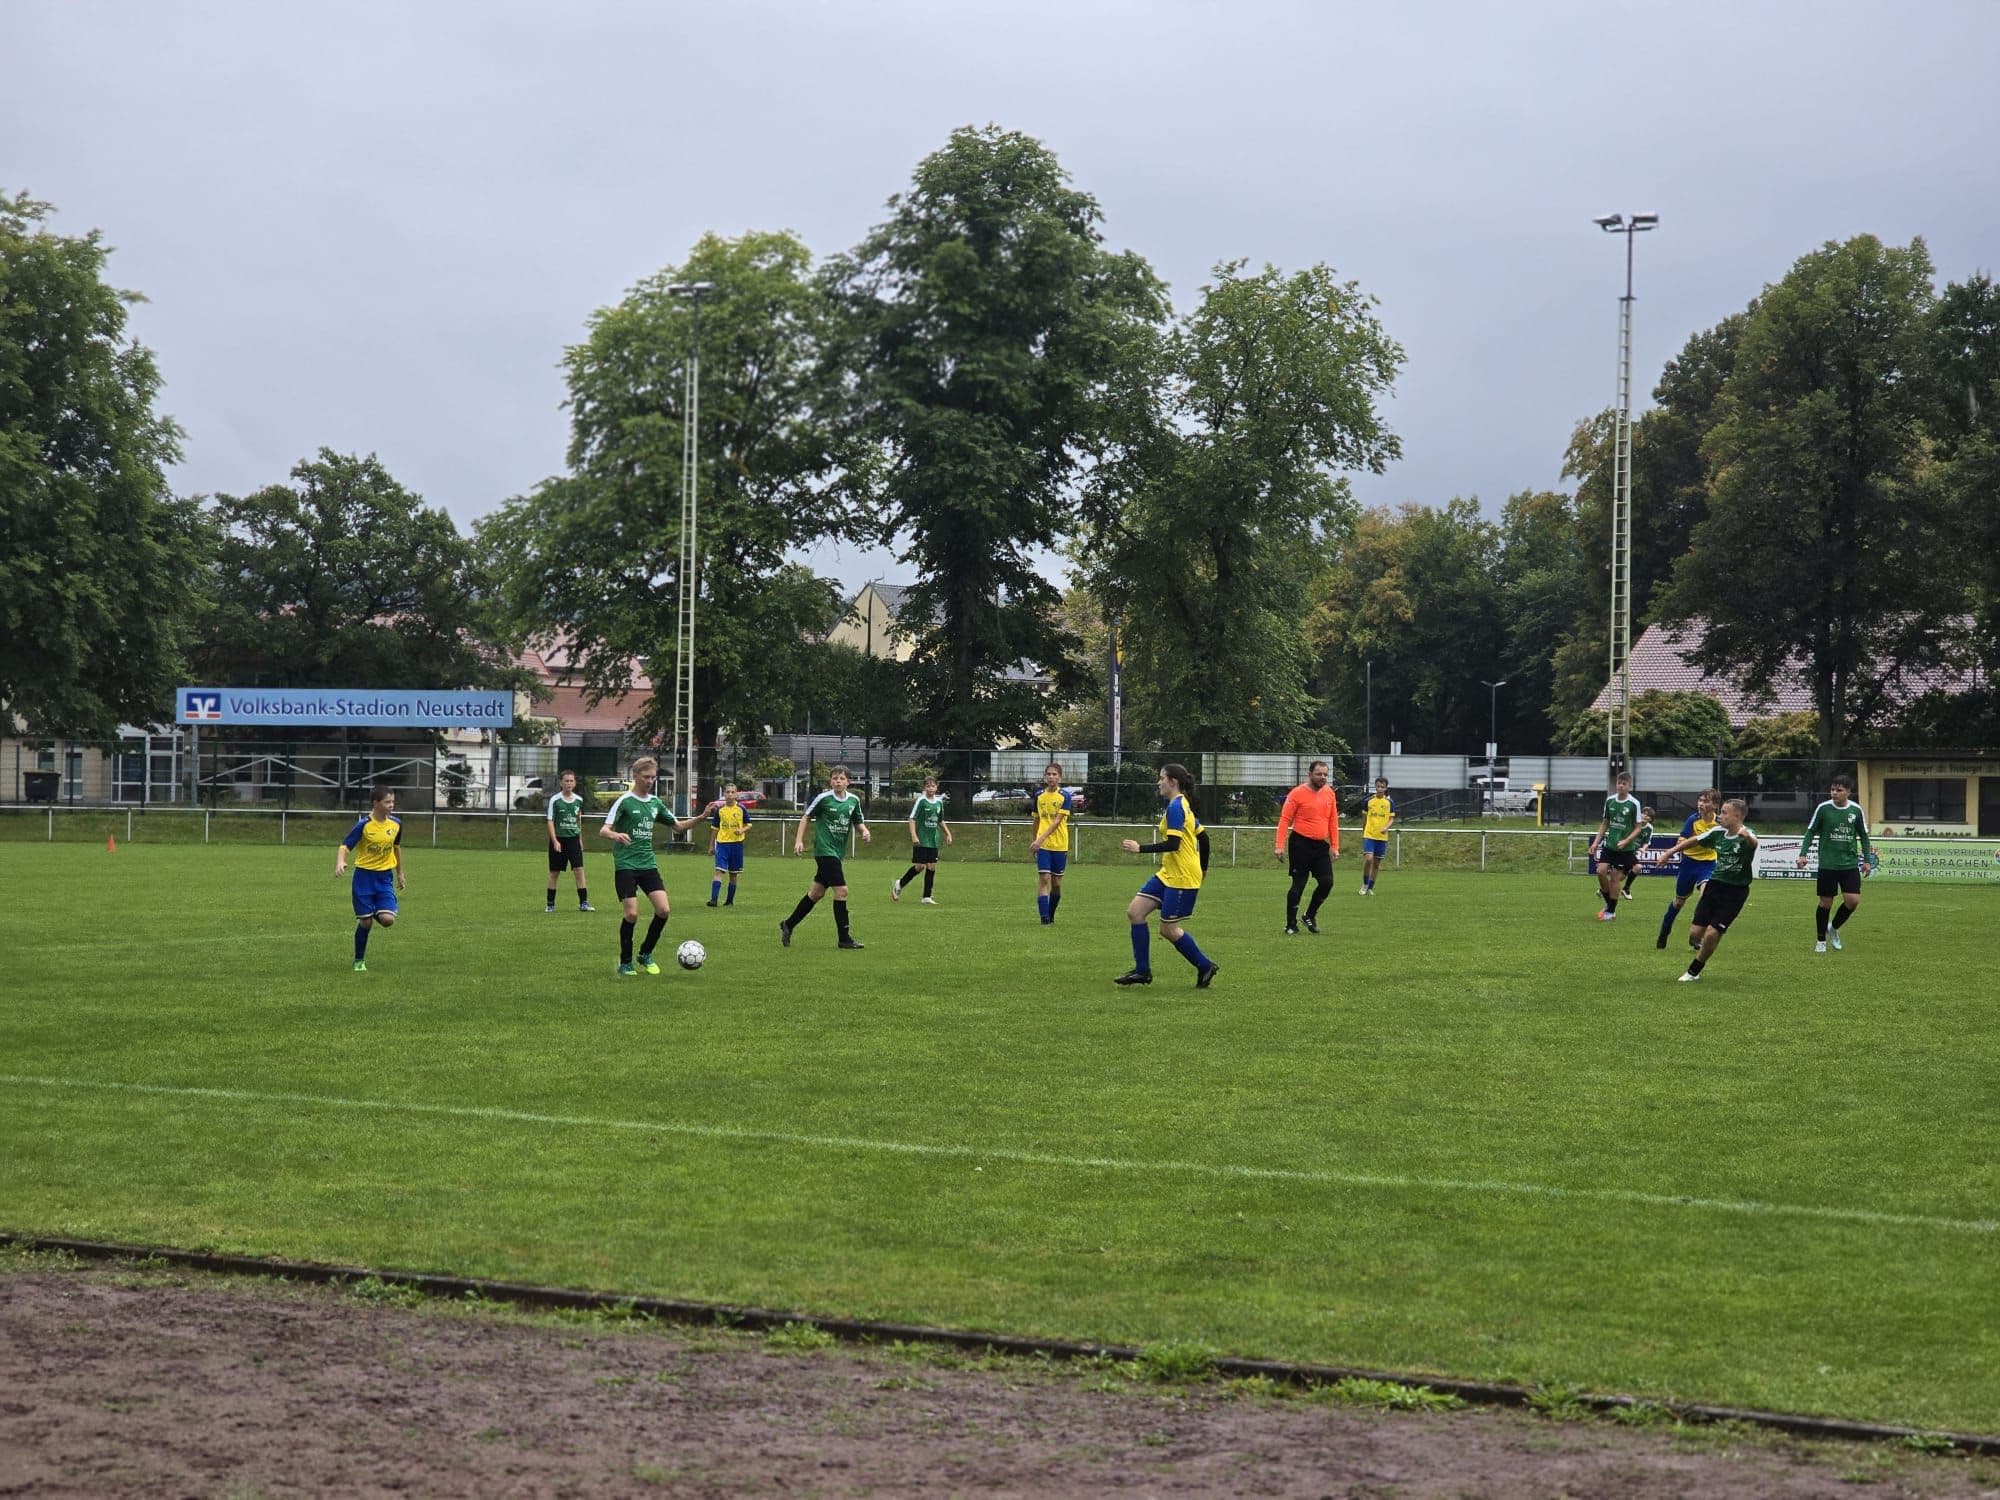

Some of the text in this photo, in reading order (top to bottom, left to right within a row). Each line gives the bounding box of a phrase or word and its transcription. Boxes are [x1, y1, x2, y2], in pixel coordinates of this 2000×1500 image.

[230, 697, 505, 717] Volksbank-Stadion Neustadt
[1889, 848, 1993, 857] FUSSBALL SPRICHT
[1889, 858, 1993, 868] ALLE SPRACHEN!
[1960, 871, 1993, 879] KEINE!
